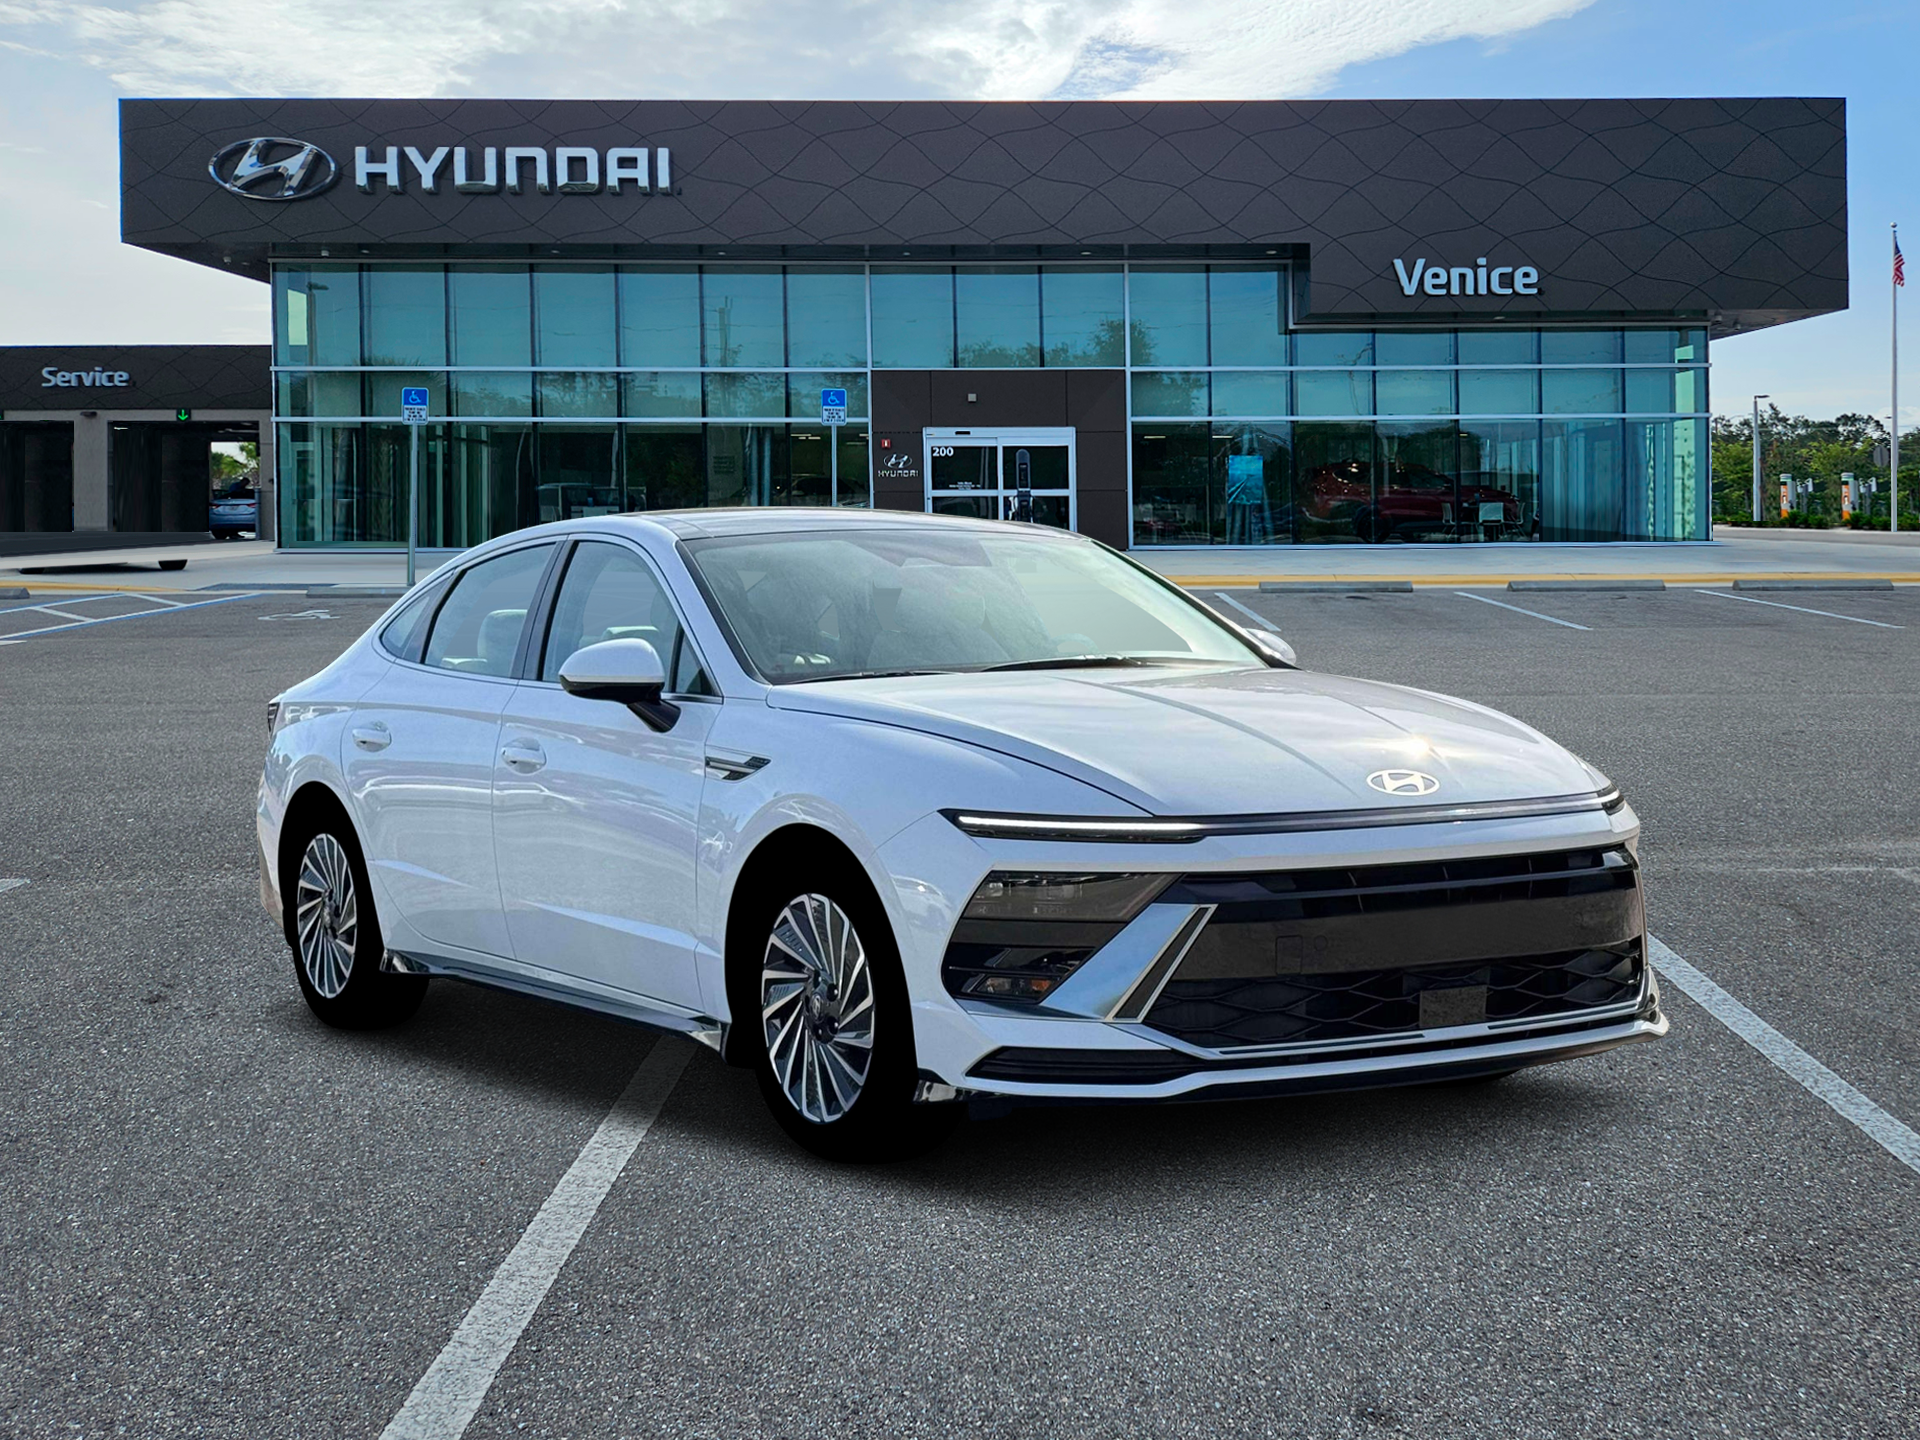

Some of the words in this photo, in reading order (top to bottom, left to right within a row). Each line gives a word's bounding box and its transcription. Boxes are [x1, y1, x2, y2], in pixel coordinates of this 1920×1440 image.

[354, 146, 671, 194] HYUNDAI
[1392, 257, 1539, 296] Venice
[41, 366, 130, 387] Service
[932, 446, 954, 457] 200
